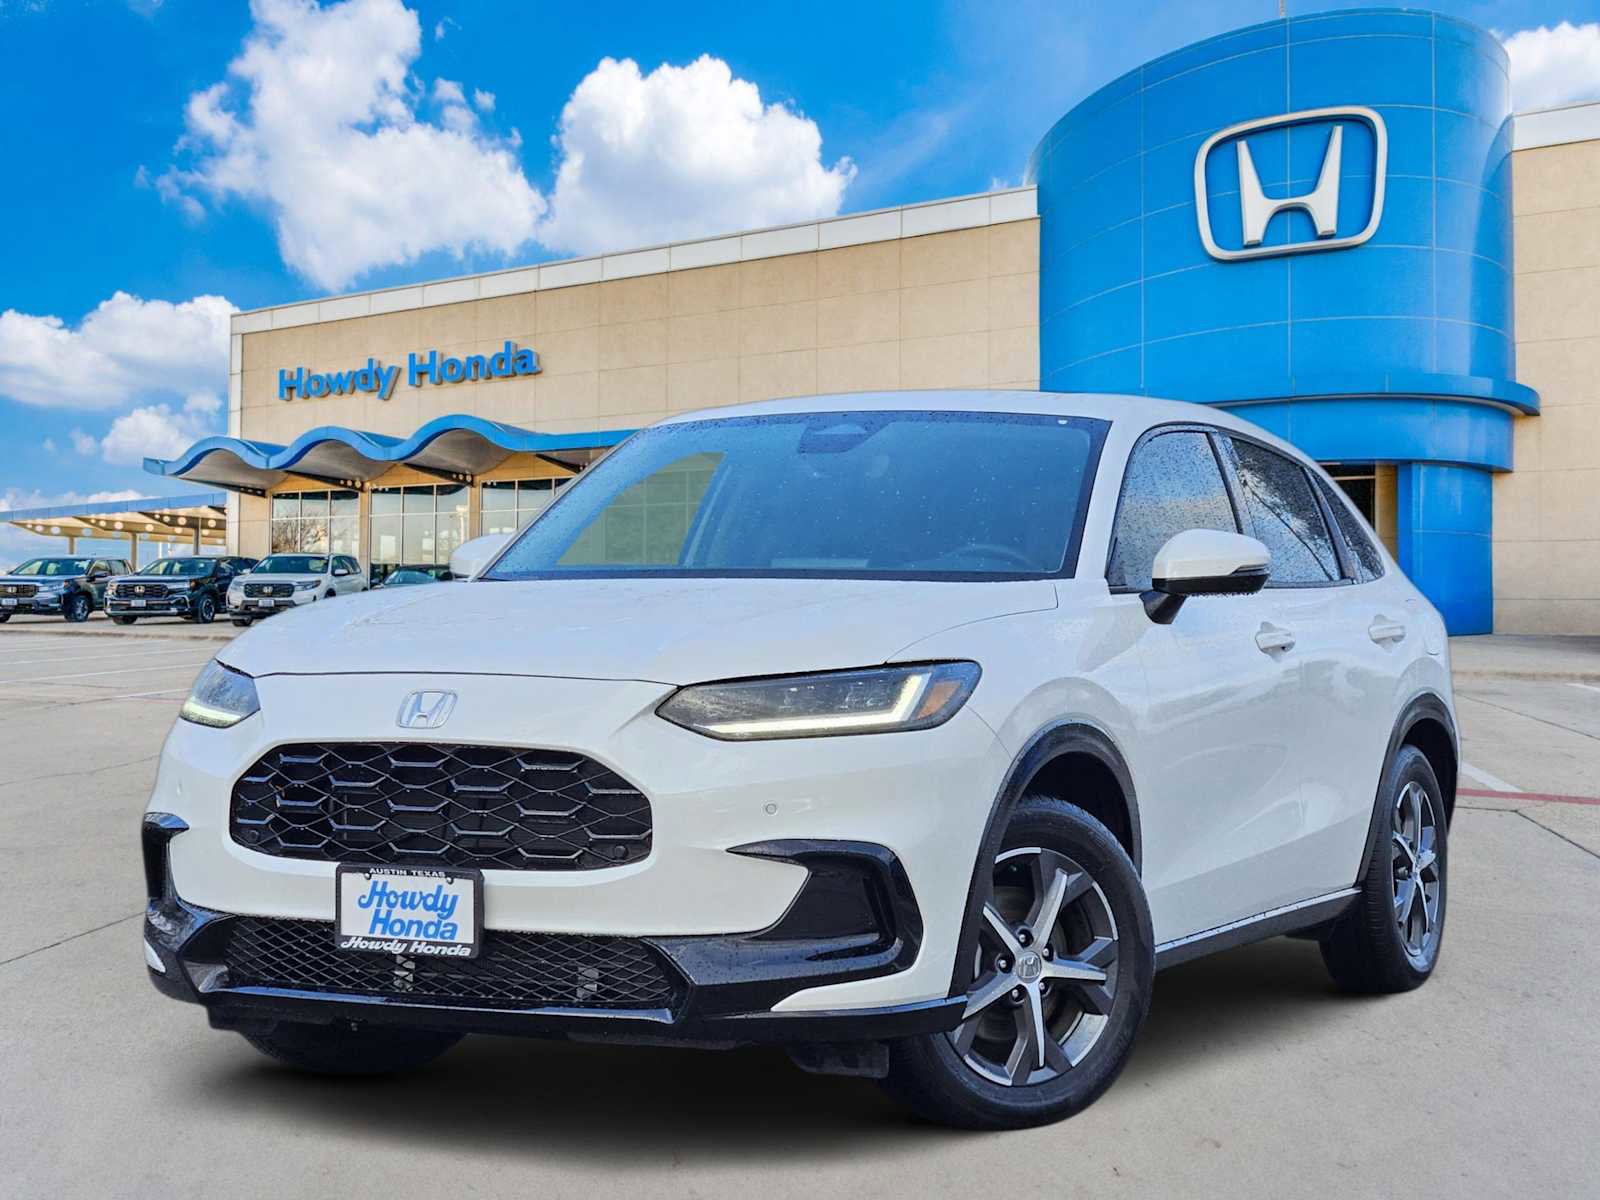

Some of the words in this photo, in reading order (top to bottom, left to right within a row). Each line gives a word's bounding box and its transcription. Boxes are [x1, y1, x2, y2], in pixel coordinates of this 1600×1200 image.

[278, 358, 401, 401] Howdy
[407, 340, 542, 388] Honda
[369, 867, 407, 876] AUSTIN
[411, 869, 446, 878] TEXAS
[357, 880, 459, 920] Howdy
[368, 909, 459, 940] Honda
[340, 936, 407, 955] Howdy
[408, 941, 472, 957] Honda
